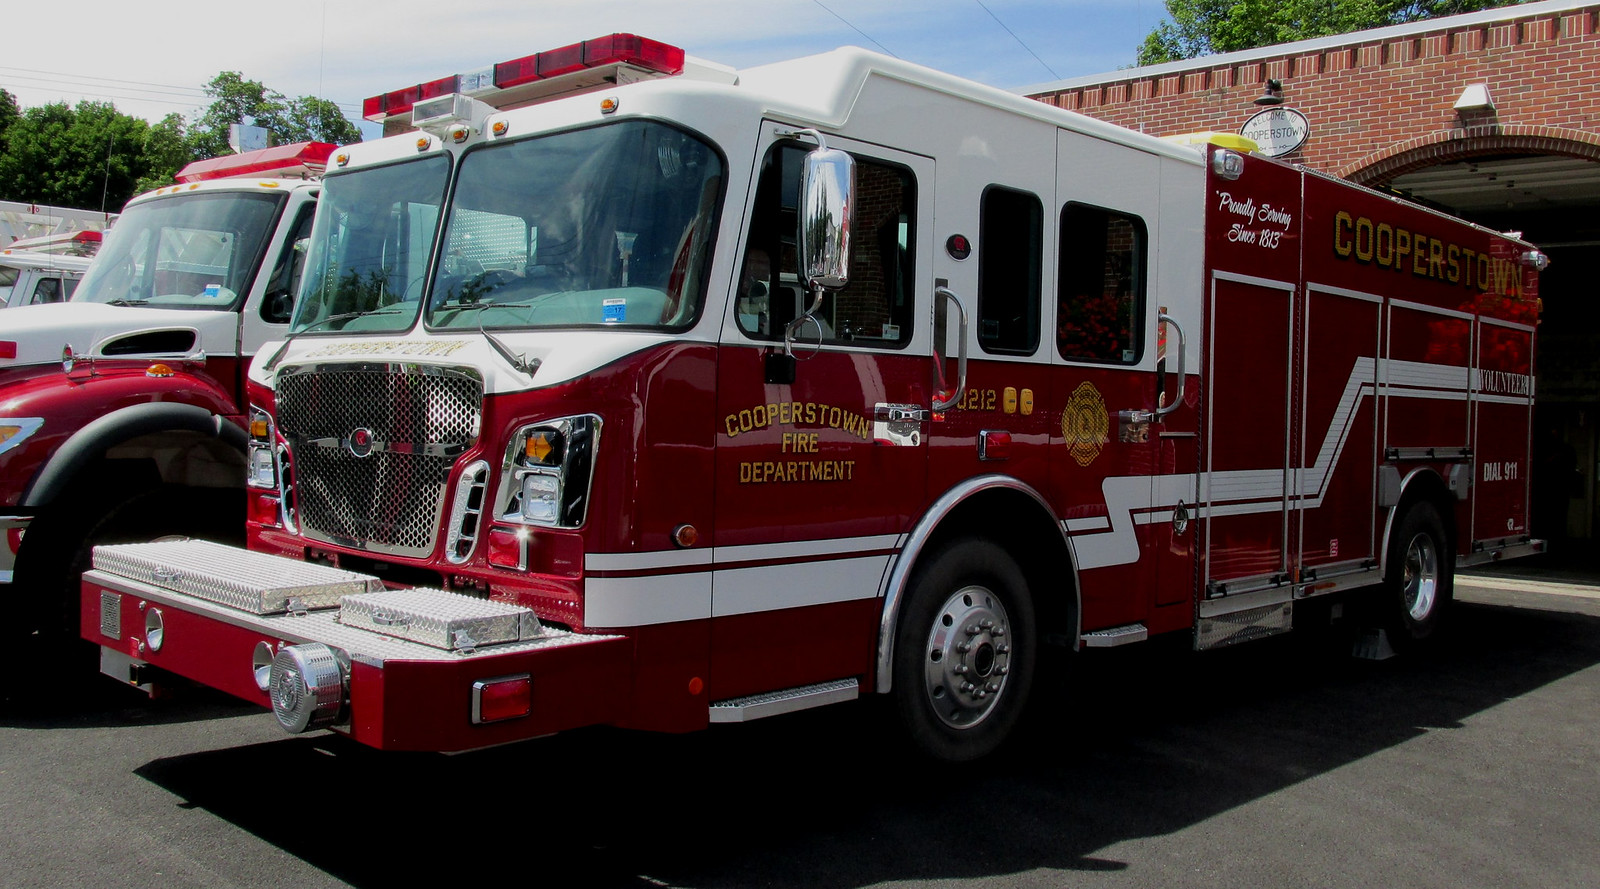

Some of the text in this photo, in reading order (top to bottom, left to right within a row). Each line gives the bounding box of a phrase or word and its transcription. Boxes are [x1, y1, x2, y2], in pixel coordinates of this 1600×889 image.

[1251, 111, 1298, 127] WELCOME TO
[1258, 204, 1291, 231] Serving
[1228, 223, 1256, 244] Since
[1335, 210, 1524, 299] COOPERSTOWN
[725, 402, 871, 440] COOPERSTOWN
[782, 432, 820, 453] FIRE
[739, 460, 855, 483] DEPARTMENT
[1484, 461, 1518, 482] DIAL 911
